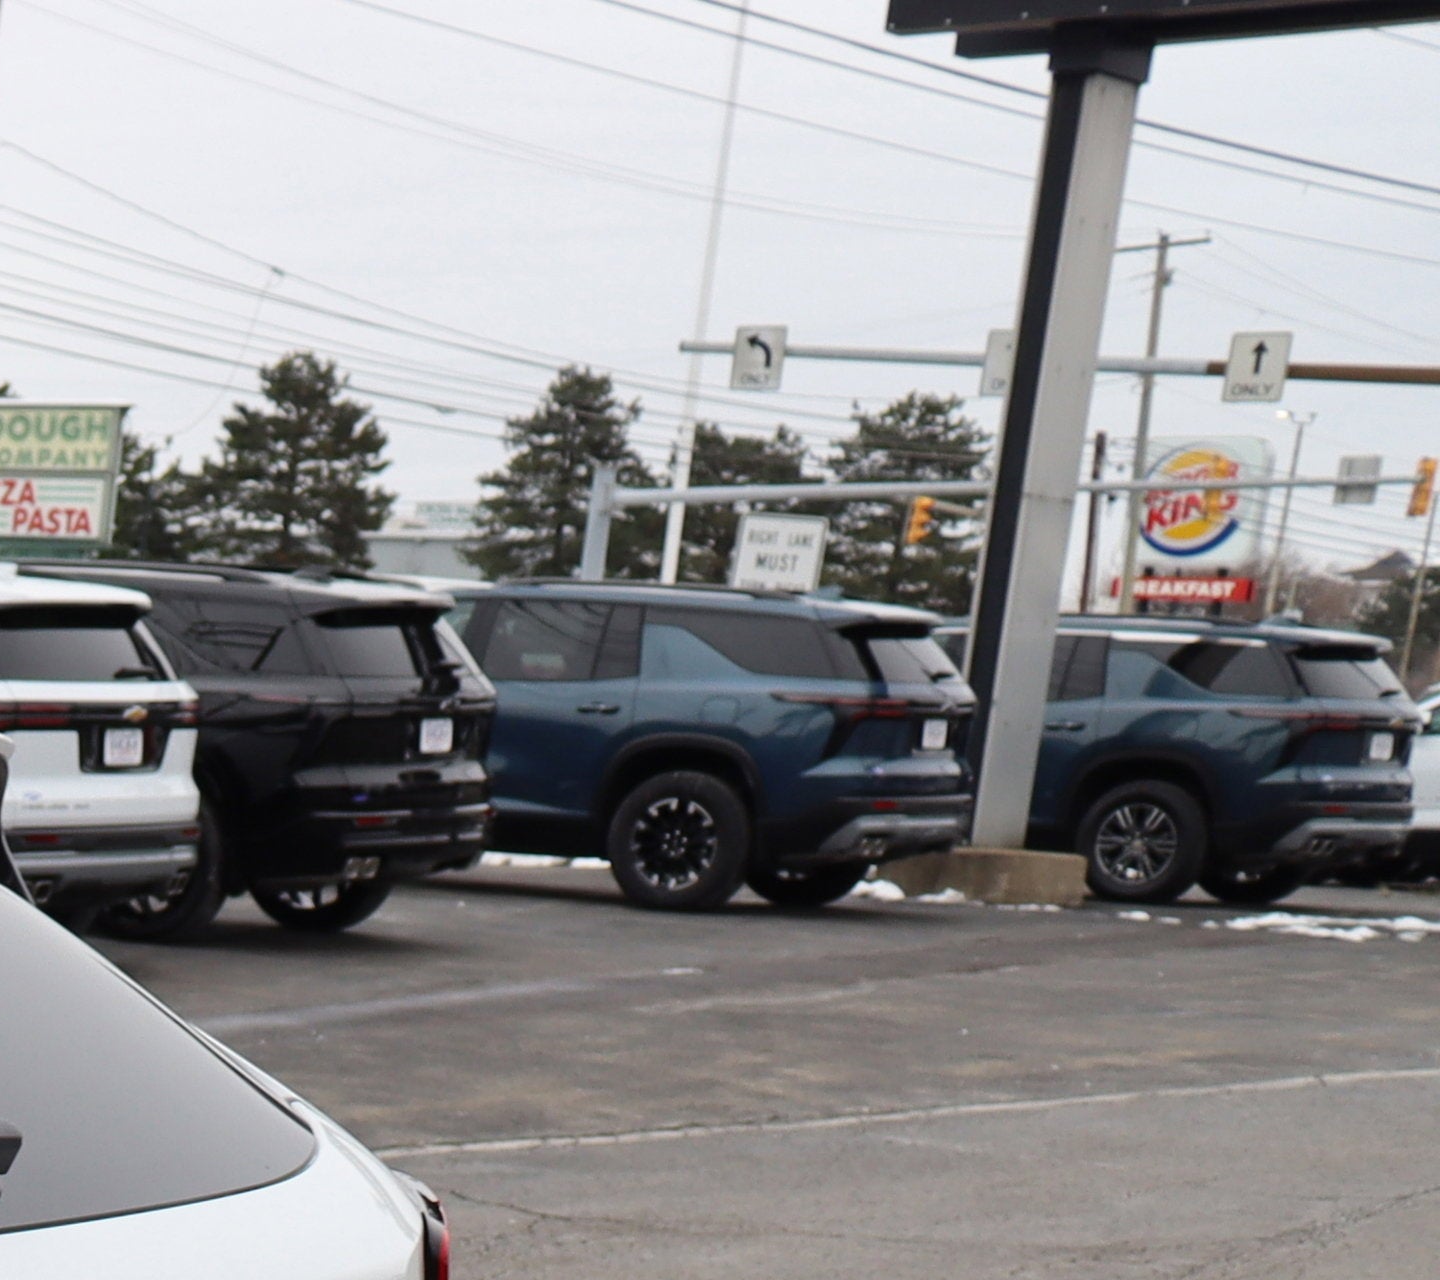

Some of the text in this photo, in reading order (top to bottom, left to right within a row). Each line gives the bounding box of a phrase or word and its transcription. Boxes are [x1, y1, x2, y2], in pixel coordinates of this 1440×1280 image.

[1231, 383, 1274, 395] ONLY
[11, 508, 91, 534] PASTA
[755, 553, 799, 572] MUST
[1133, 579, 1236, 598] REAKFAST
